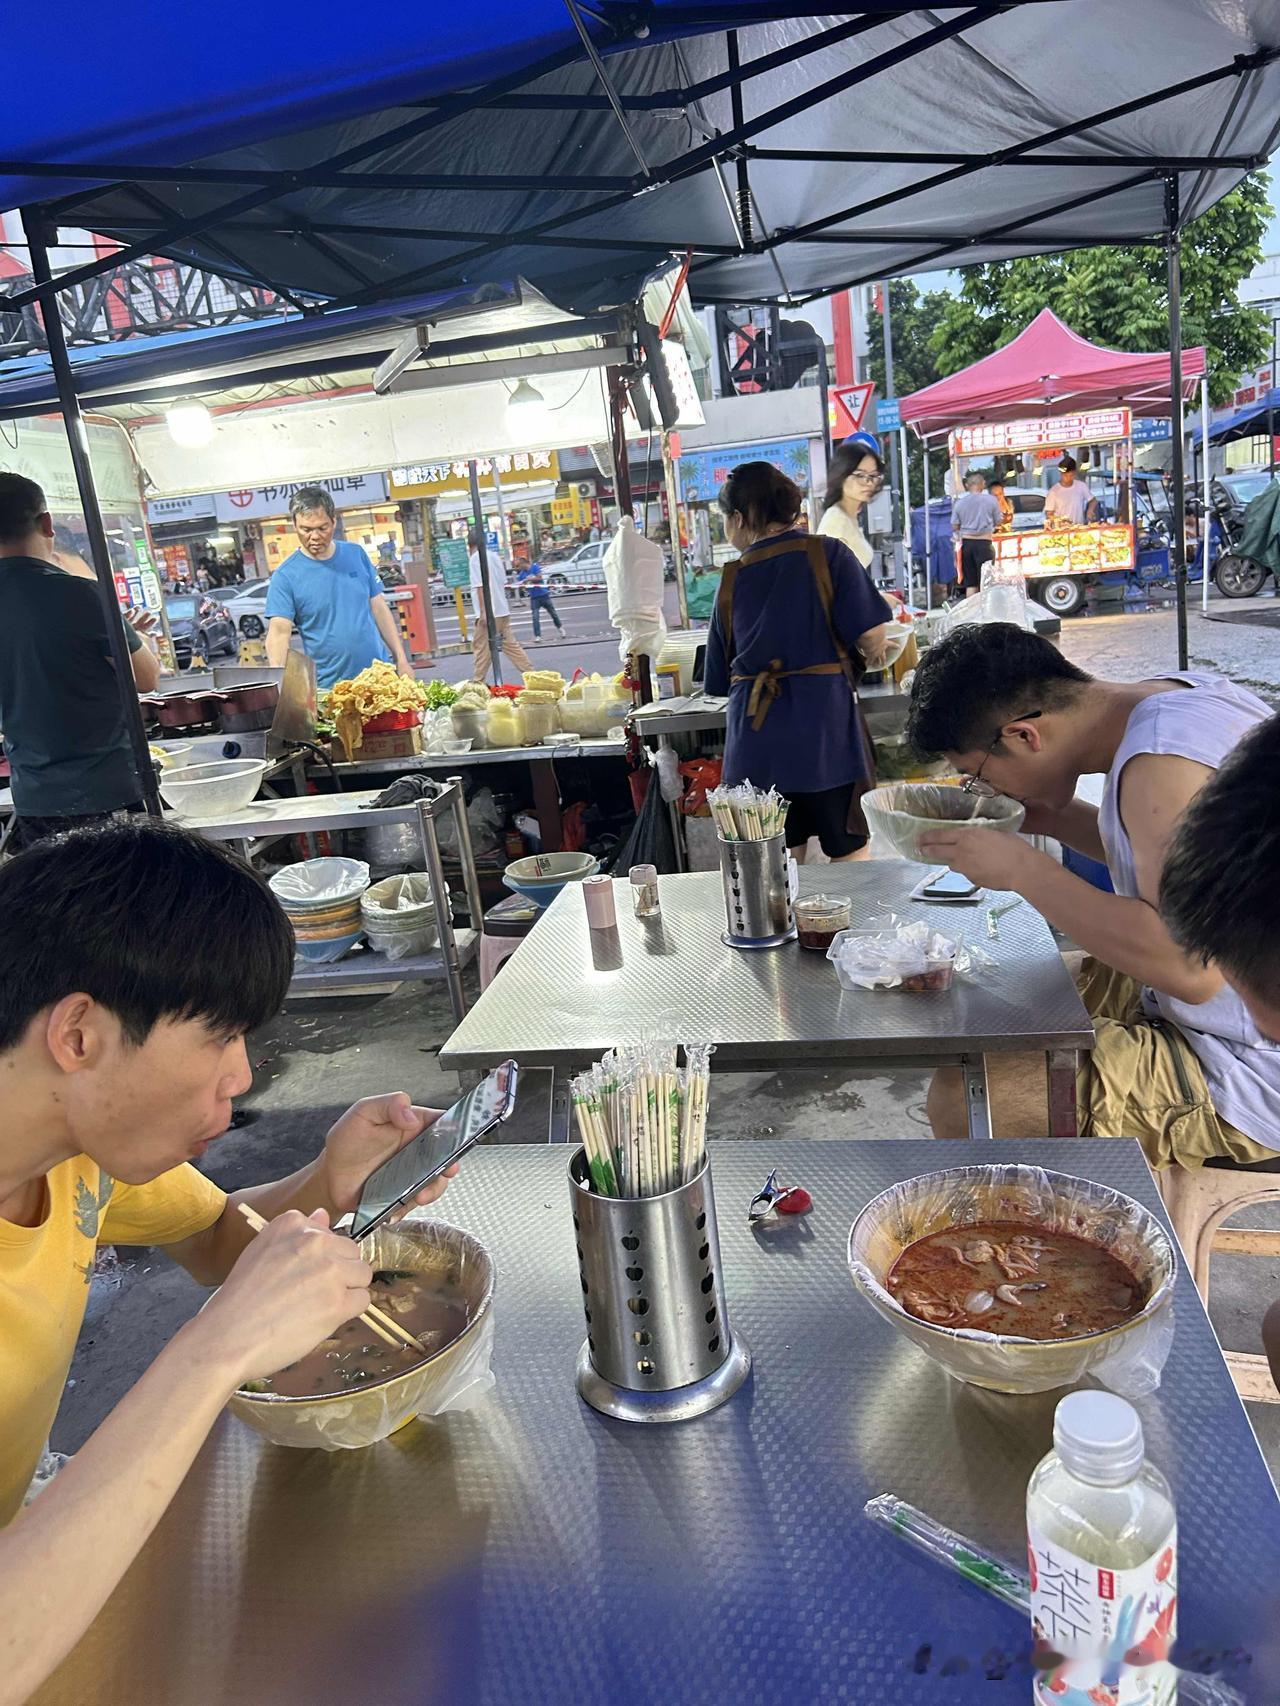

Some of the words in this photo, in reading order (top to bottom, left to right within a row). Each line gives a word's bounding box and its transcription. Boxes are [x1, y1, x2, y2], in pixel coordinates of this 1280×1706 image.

[848, 393, 860, 408] 让
[257, 475, 367, 503] 书亦仙草
